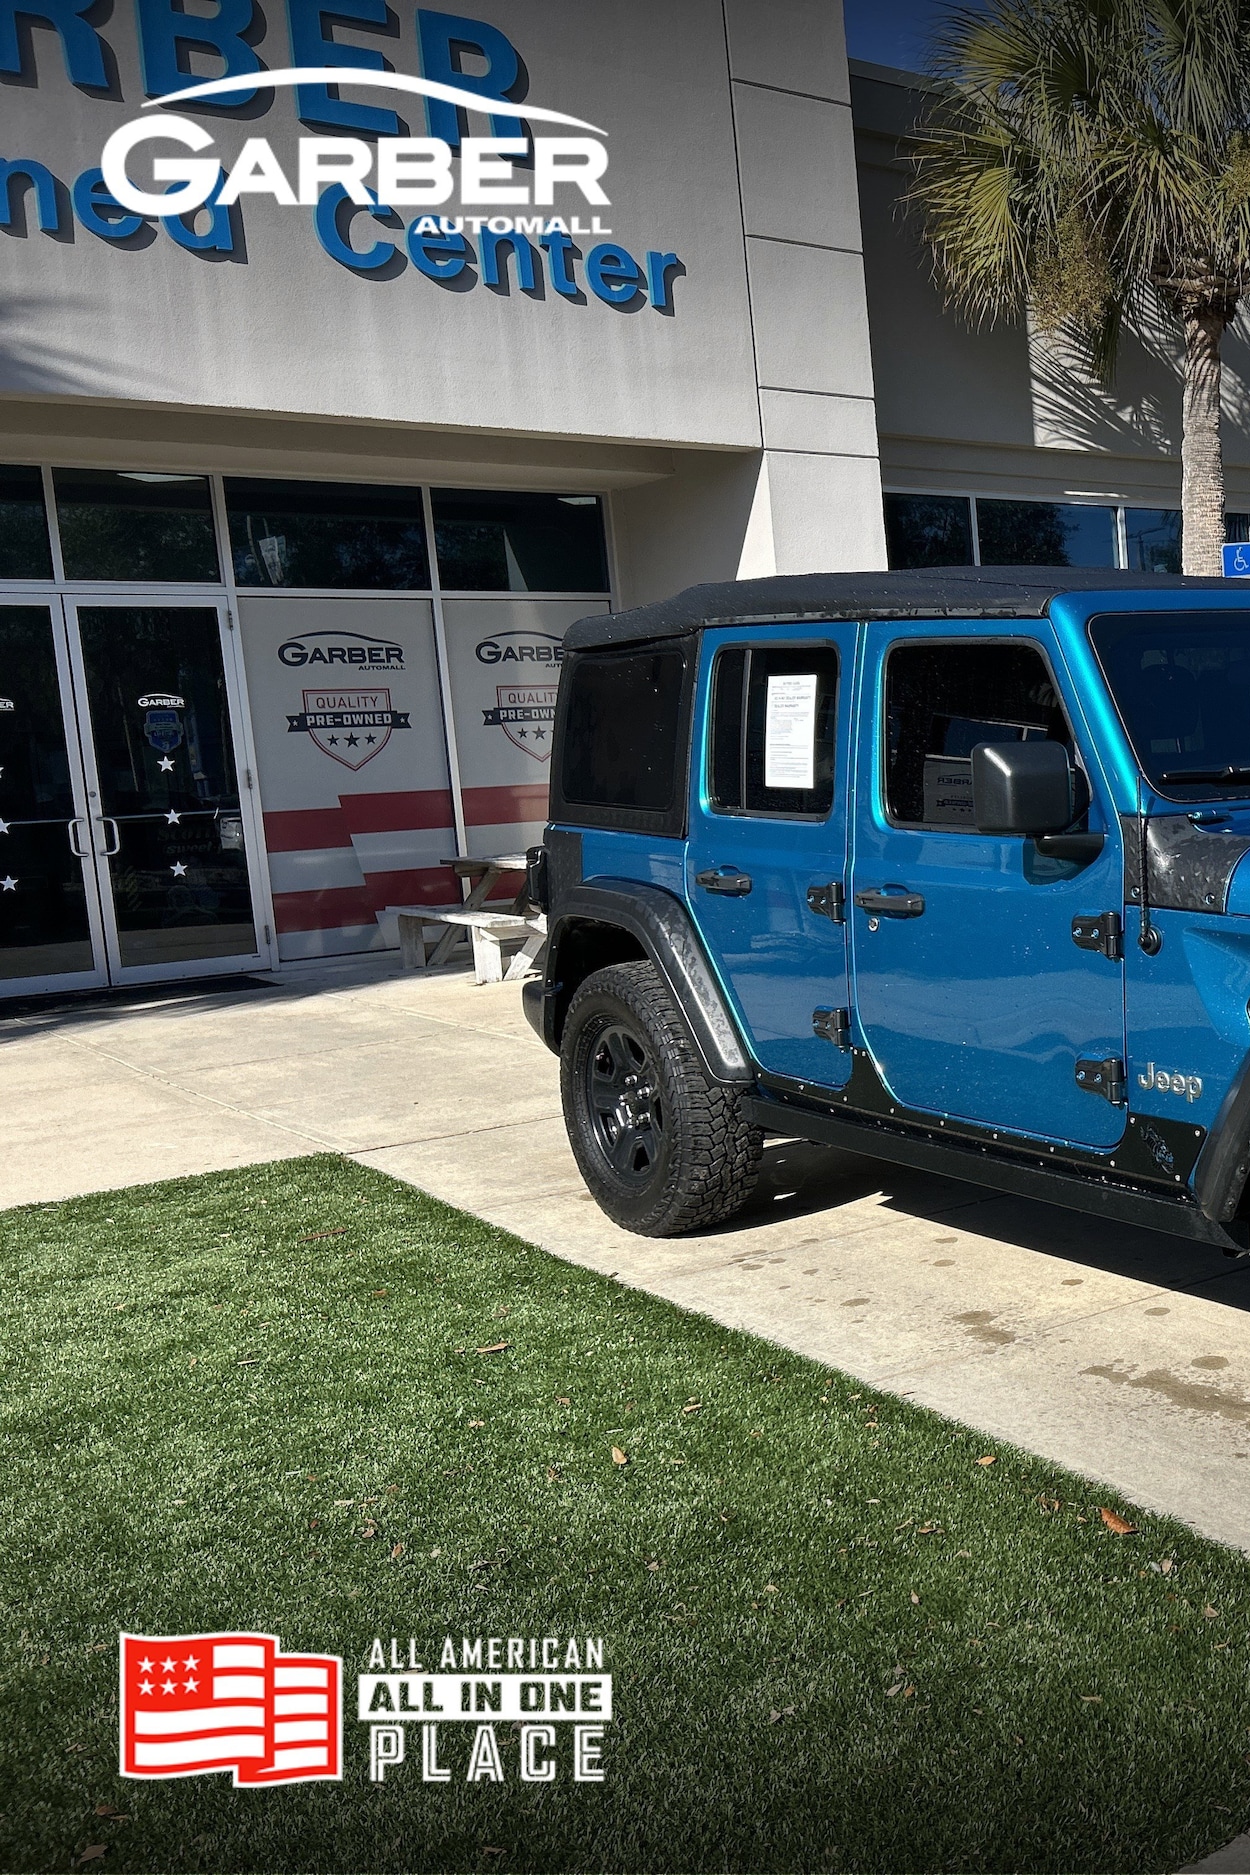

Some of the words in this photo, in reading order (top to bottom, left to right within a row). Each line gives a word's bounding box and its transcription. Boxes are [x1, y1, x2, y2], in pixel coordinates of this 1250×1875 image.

[313, 181, 677, 307] Center
[278, 642, 405, 667] GARBER
[475, 641, 564, 664] GARBE
[137, 697, 185, 707] GARBER
[316, 696, 378, 709] QUALITY
[508, 692, 558, 704] QUALIT
[306, 713, 392, 727] PRE-OWNED
[1138, 1062, 1203, 1104] Jeep
